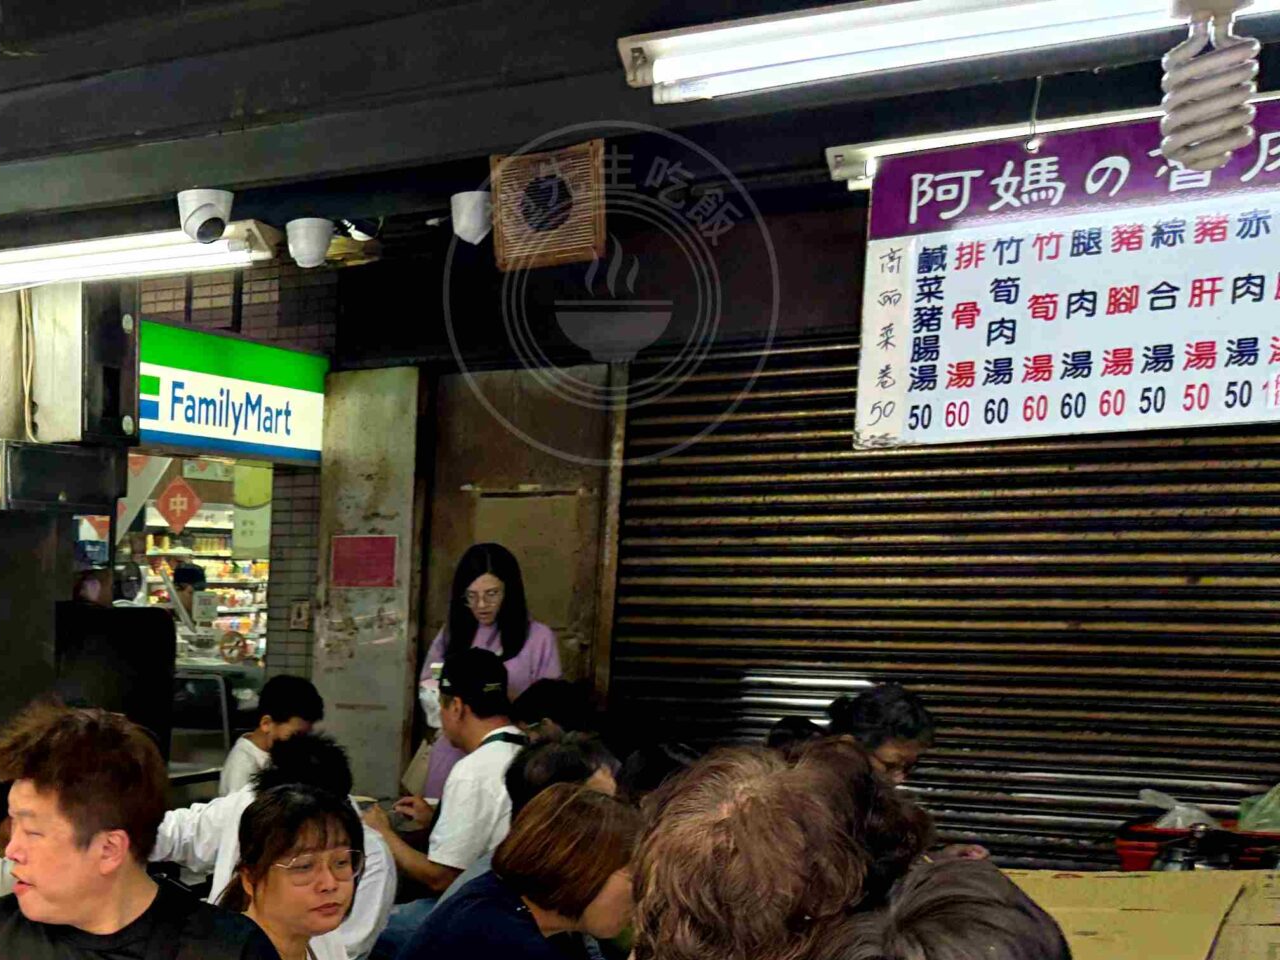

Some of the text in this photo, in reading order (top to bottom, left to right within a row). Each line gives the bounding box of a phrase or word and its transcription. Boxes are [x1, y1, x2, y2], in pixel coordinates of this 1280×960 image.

[908, 130, 1280, 225] 阿媽の
[906, 244, 948, 430] 鹹菜豬腸湯 50
[944, 241, 987, 428] 排骨湯 60
[982, 235, 1025, 425] 竹筍肉湯 60
[1021, 231, 1065, 422] 竹筍湯 60
[1059, 226, 1103, 420] 腿肉湯 60
[1098, 388, 1126, 417] 60
[1138, 217, 1188, 415] 綜合湯 50
[1181, 212, 1231, 412] 豬肝湯 50
[1222, 208, 1273, 410] 赤肉湯 50
[170, 380, 292, 436] FamilyMart
[867, 400, 896, 426] 50
